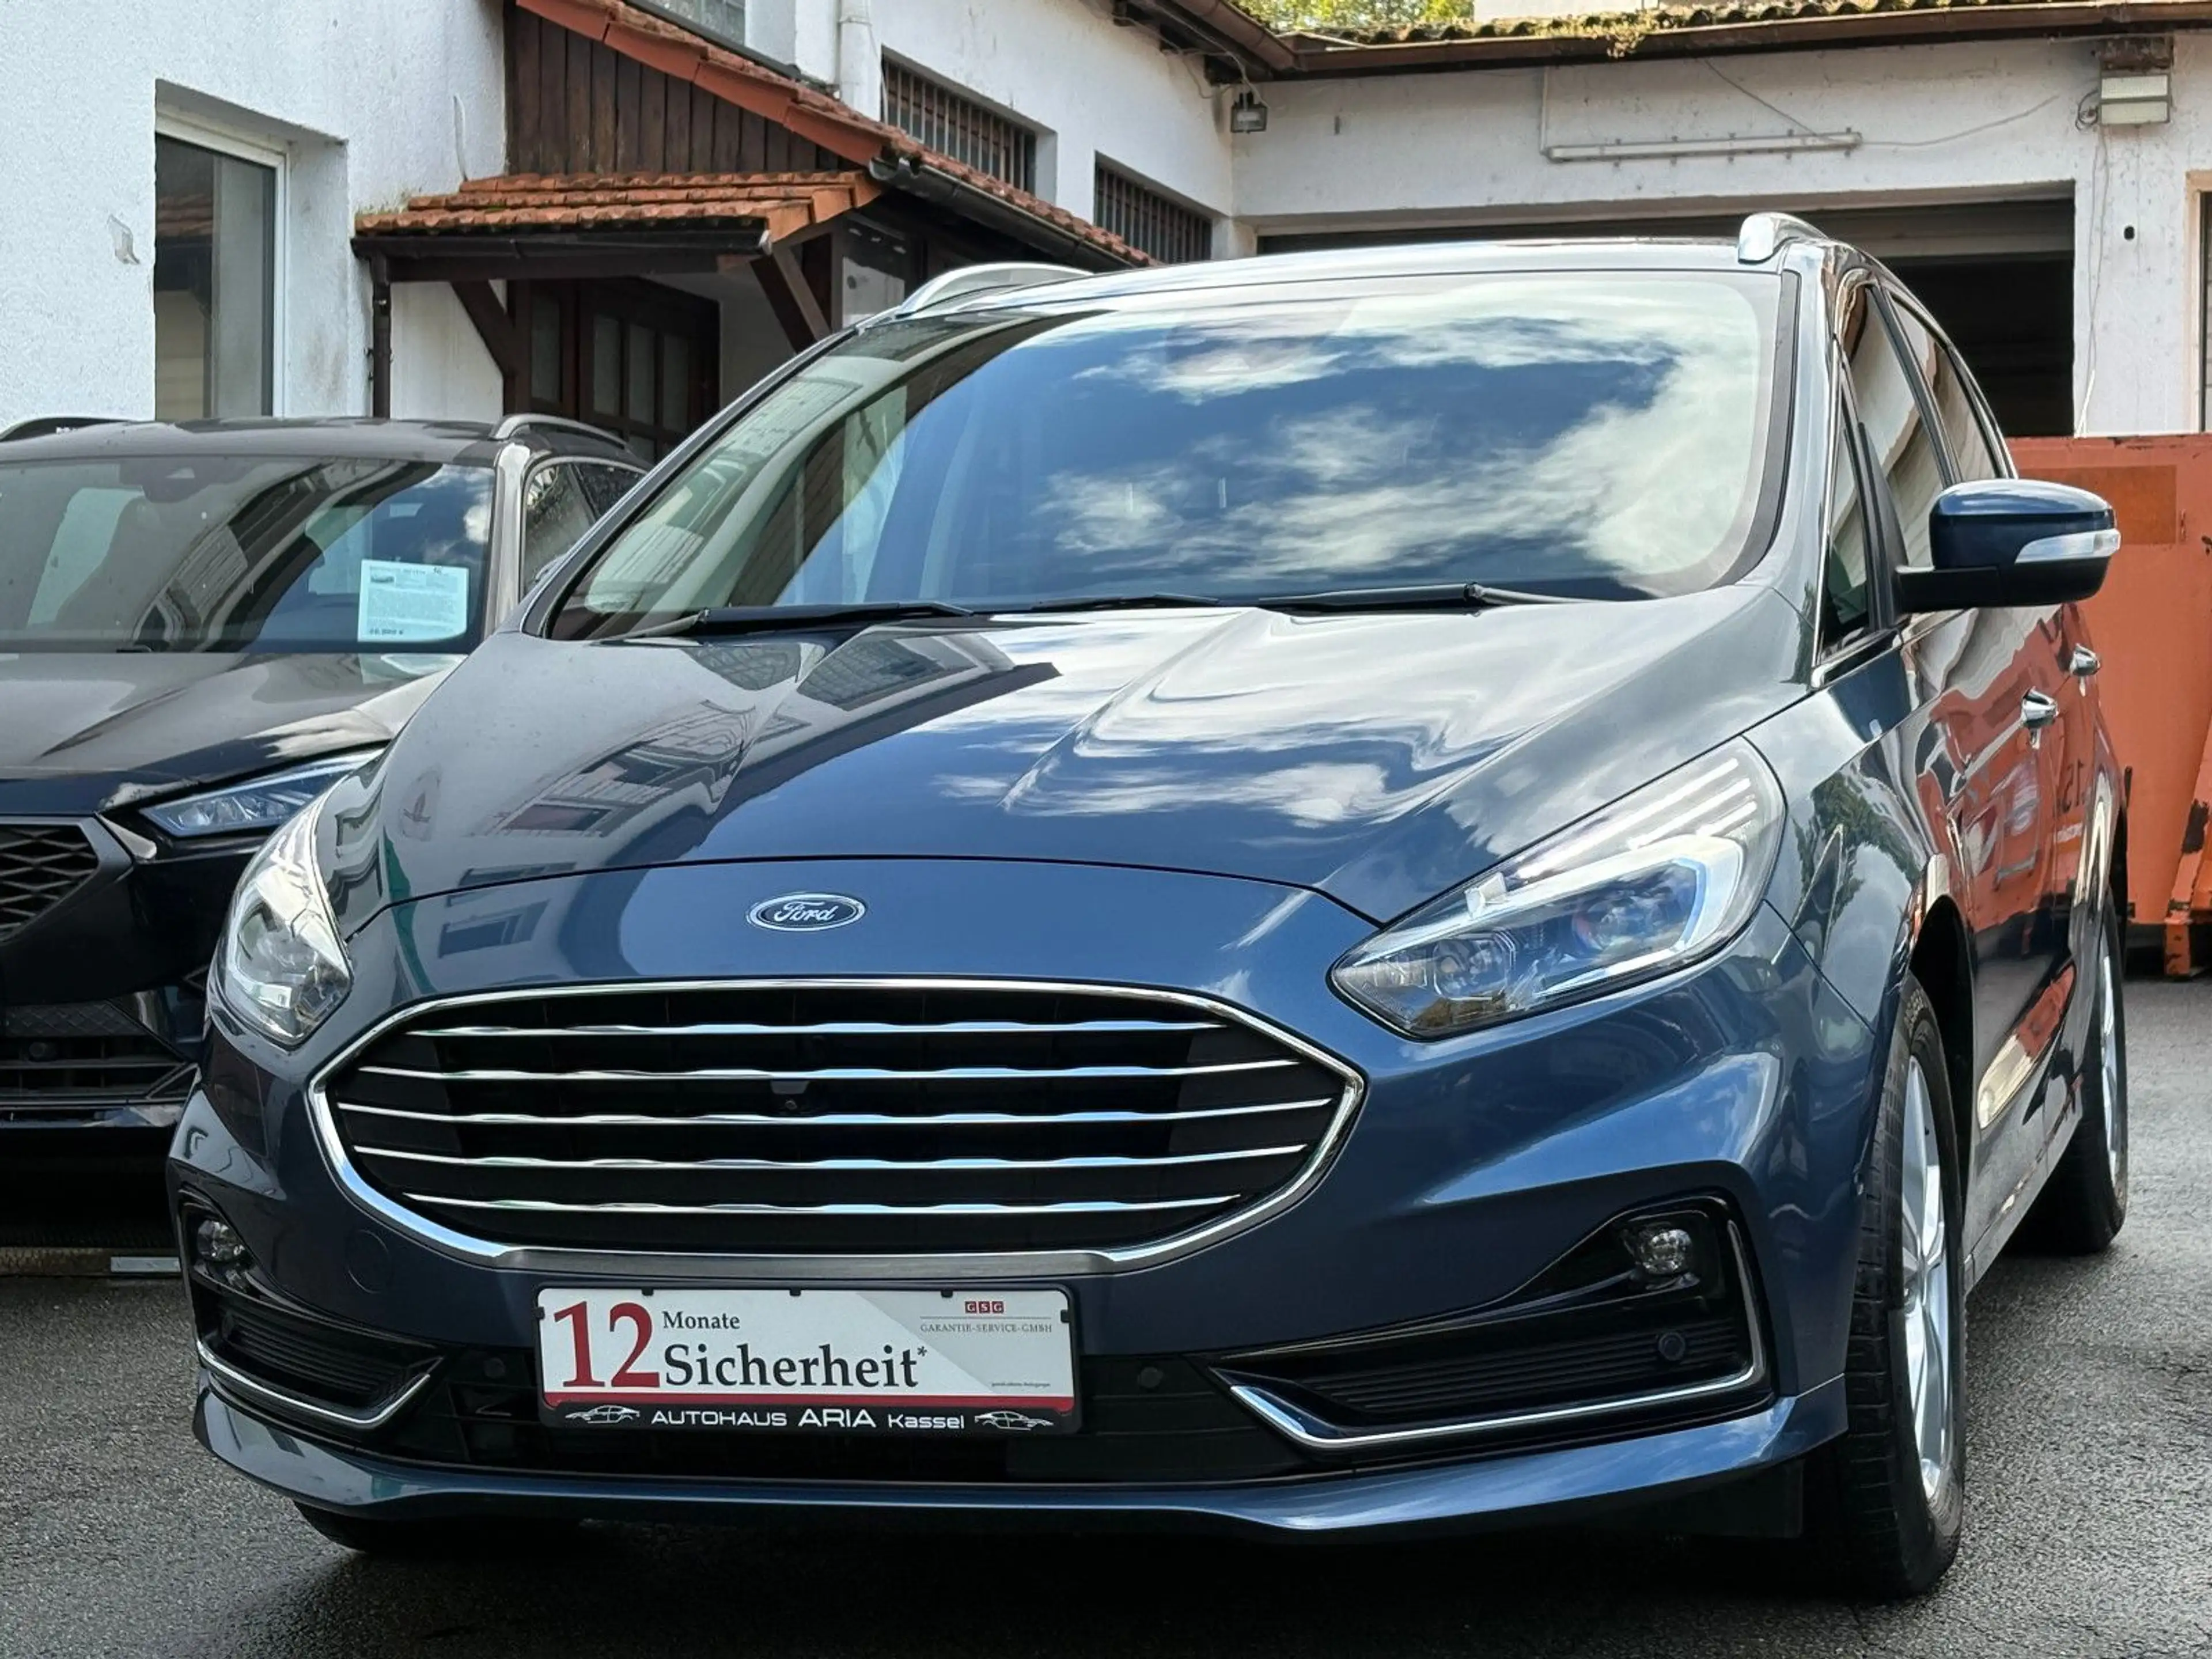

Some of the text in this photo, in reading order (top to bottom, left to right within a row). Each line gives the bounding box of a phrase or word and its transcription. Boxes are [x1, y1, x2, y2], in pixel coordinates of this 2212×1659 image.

[774, 901, 839, 922] Ford
[965, 1301, 1003, 1313] GSG
[662, 1310, 740, 1330] Monate
[554, 1301, 660, 1388] 12
[651, 1408, 965, 1429] AUTOHAUS ARIA Kassel
